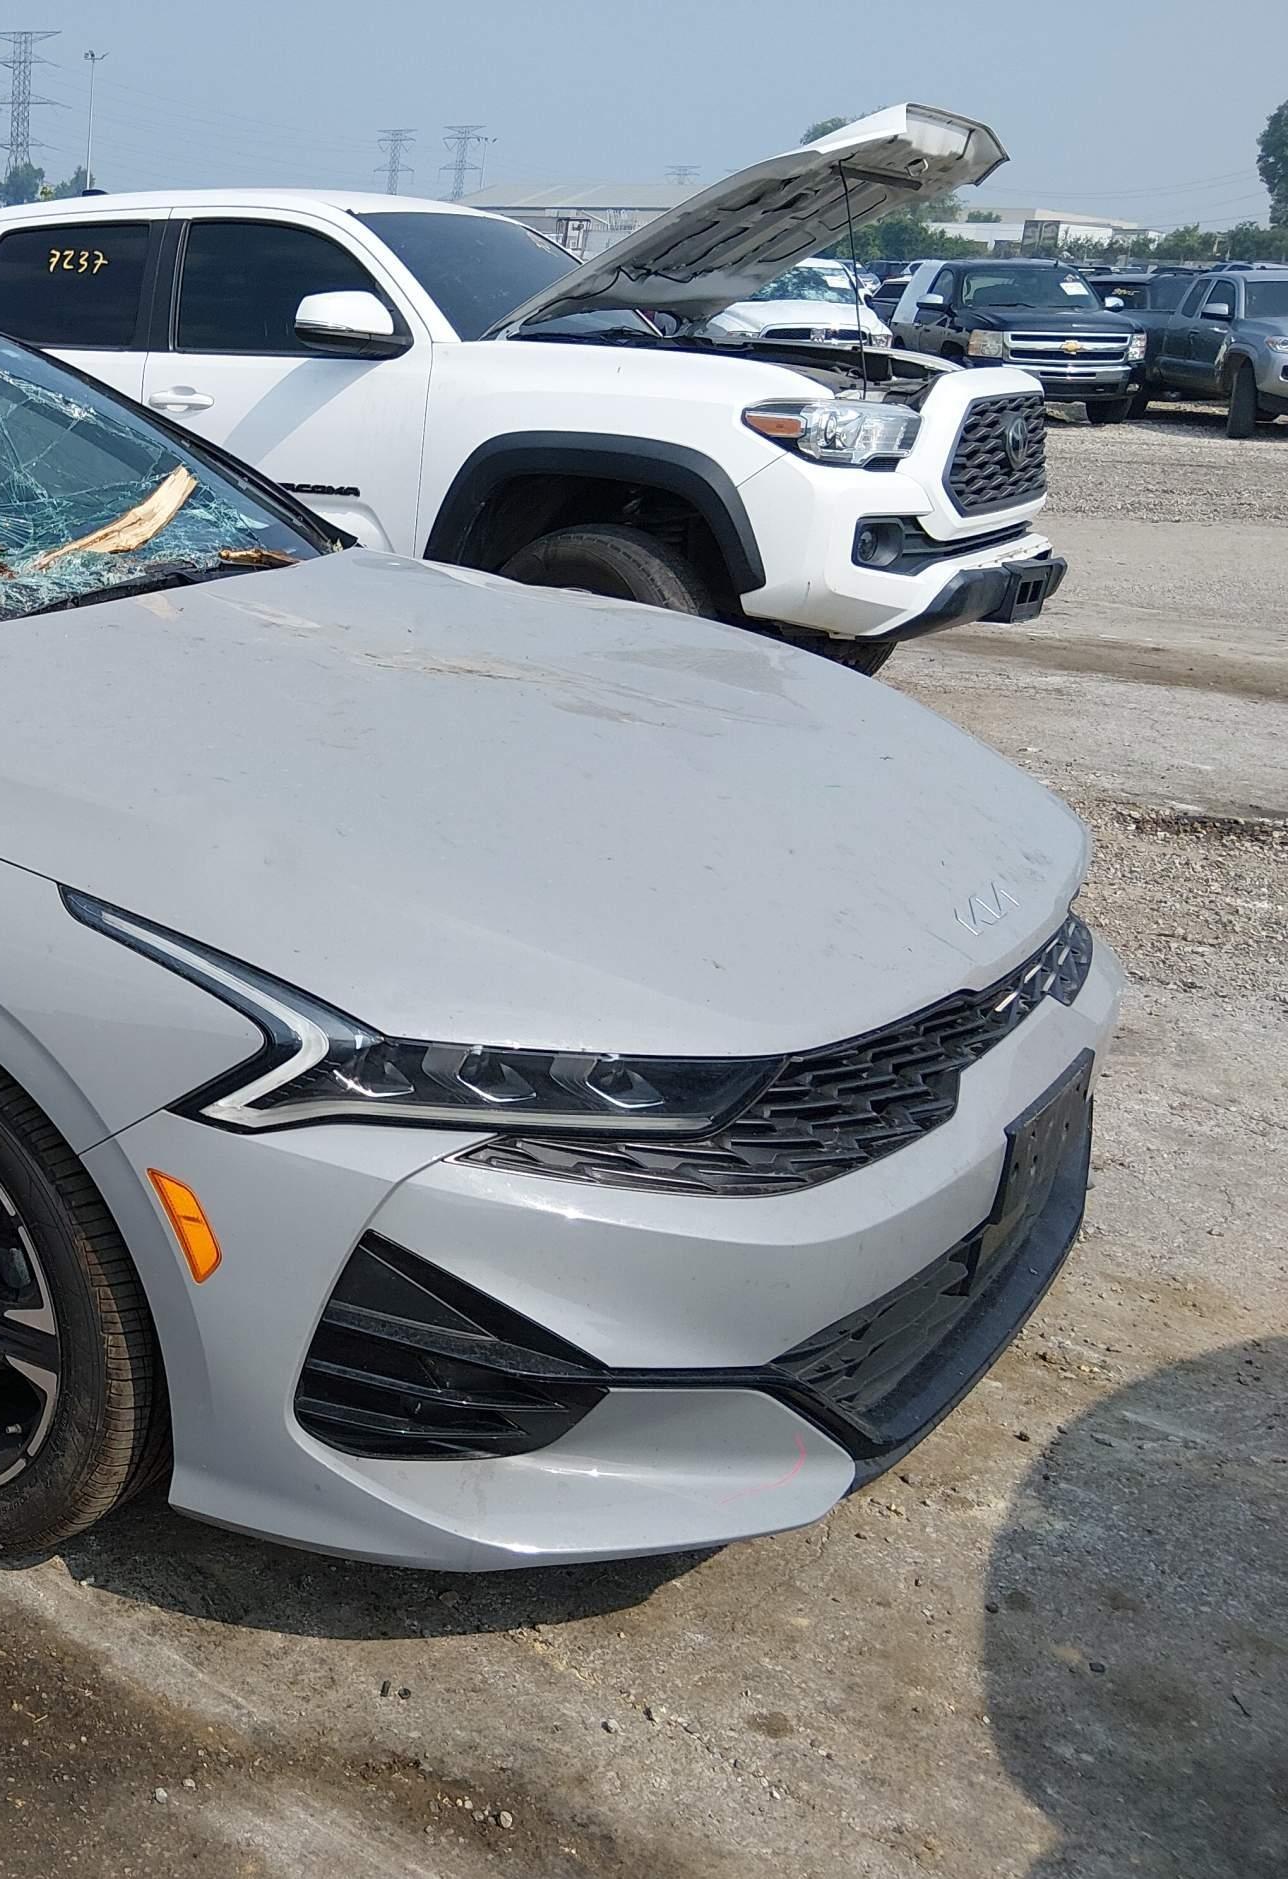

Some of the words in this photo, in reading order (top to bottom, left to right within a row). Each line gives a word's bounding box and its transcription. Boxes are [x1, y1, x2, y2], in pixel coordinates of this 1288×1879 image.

[49, 249, 109, 275] 7237
[277, 482, 361, 498] ACOMA
[953, 880, 1021, 937] KIA
